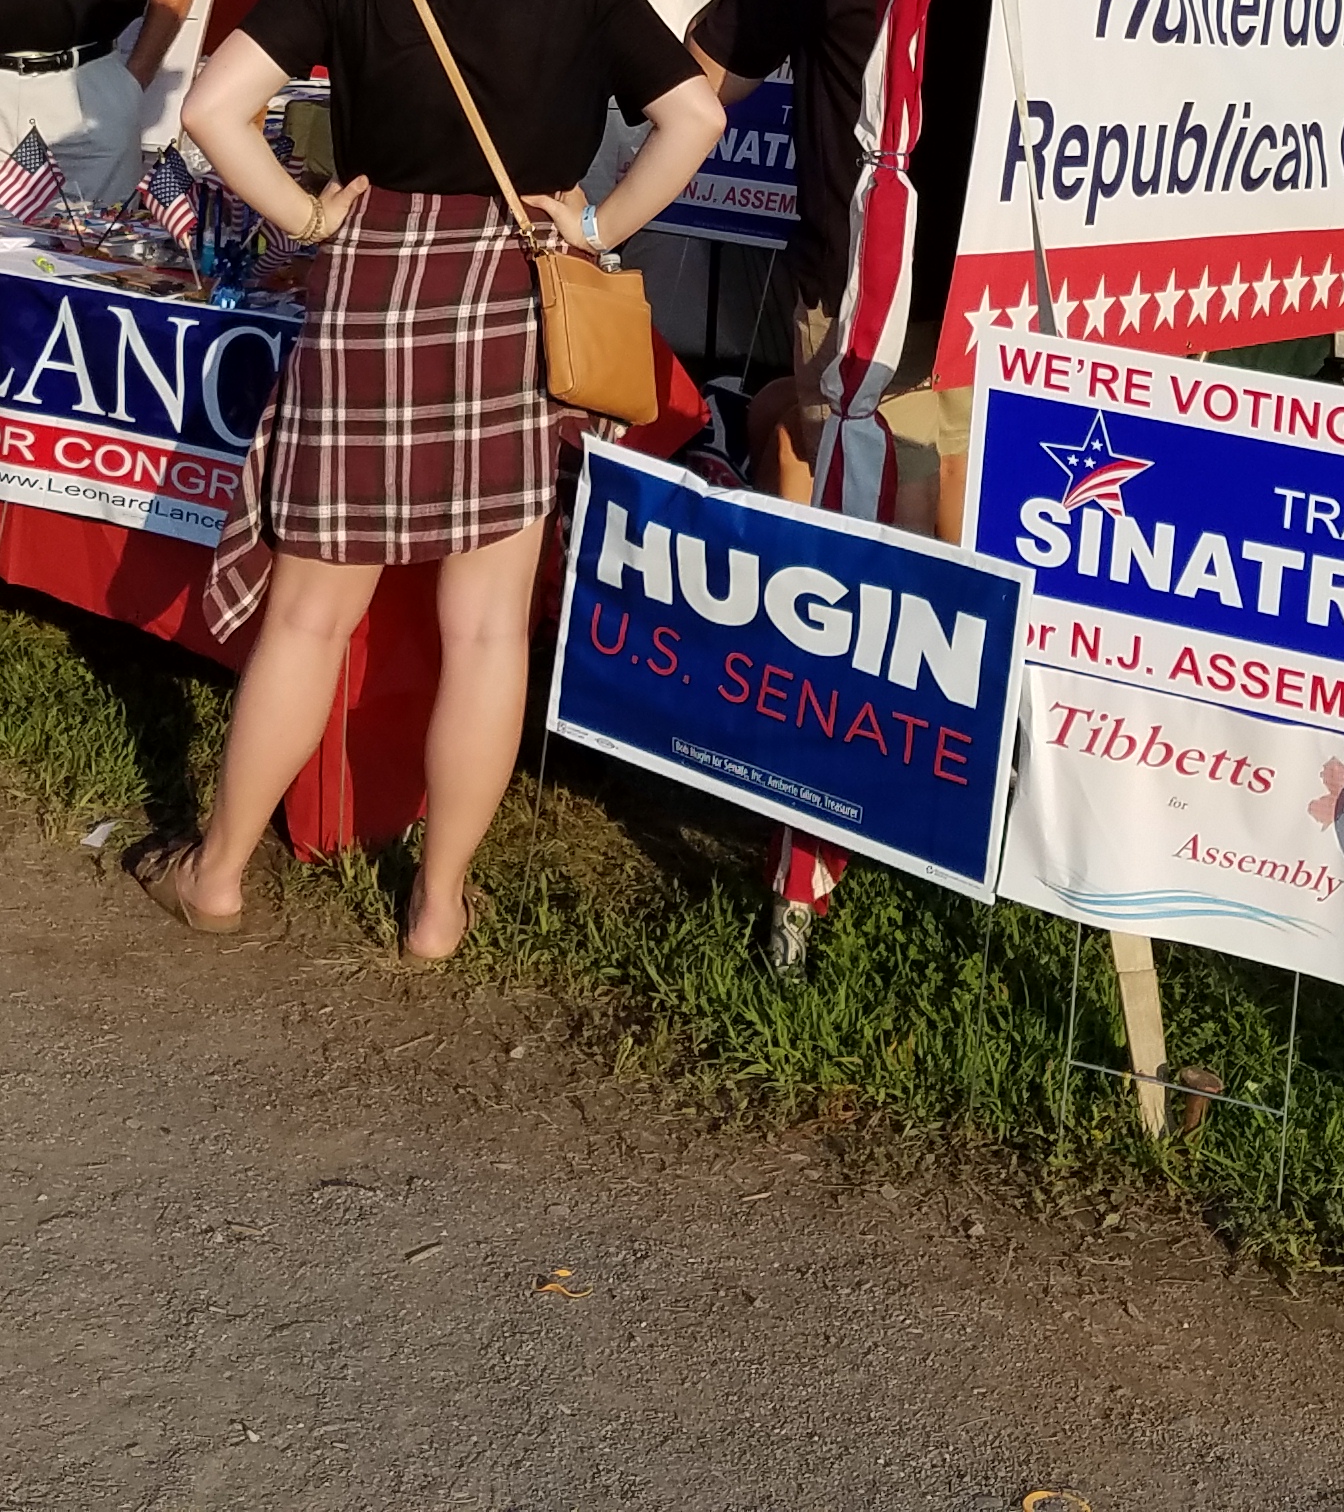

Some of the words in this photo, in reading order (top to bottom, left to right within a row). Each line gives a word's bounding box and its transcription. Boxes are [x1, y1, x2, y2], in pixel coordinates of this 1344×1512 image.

[1000, 100, 1329, 225] Republican
[722, 185, 796, 215] ASSEM
[998, 344, 1154, 409] WE'RE
[53, 437, 239, 502] CONGR
[596, 500, 987, 709] HUGIN
[1071, 621, 1153, 675] N.J.
[590, 602, 691, 685] U.S.
[718, 651, 973, 786] SENATE
[1046, 701, 1277, 794] Tibbetts
[690, 746, 711, 765] Hugin
[712, 752, 723, 768] for
[824, 795, 859, 819] Treasurer
[1167, 796, 1188, 812] for
